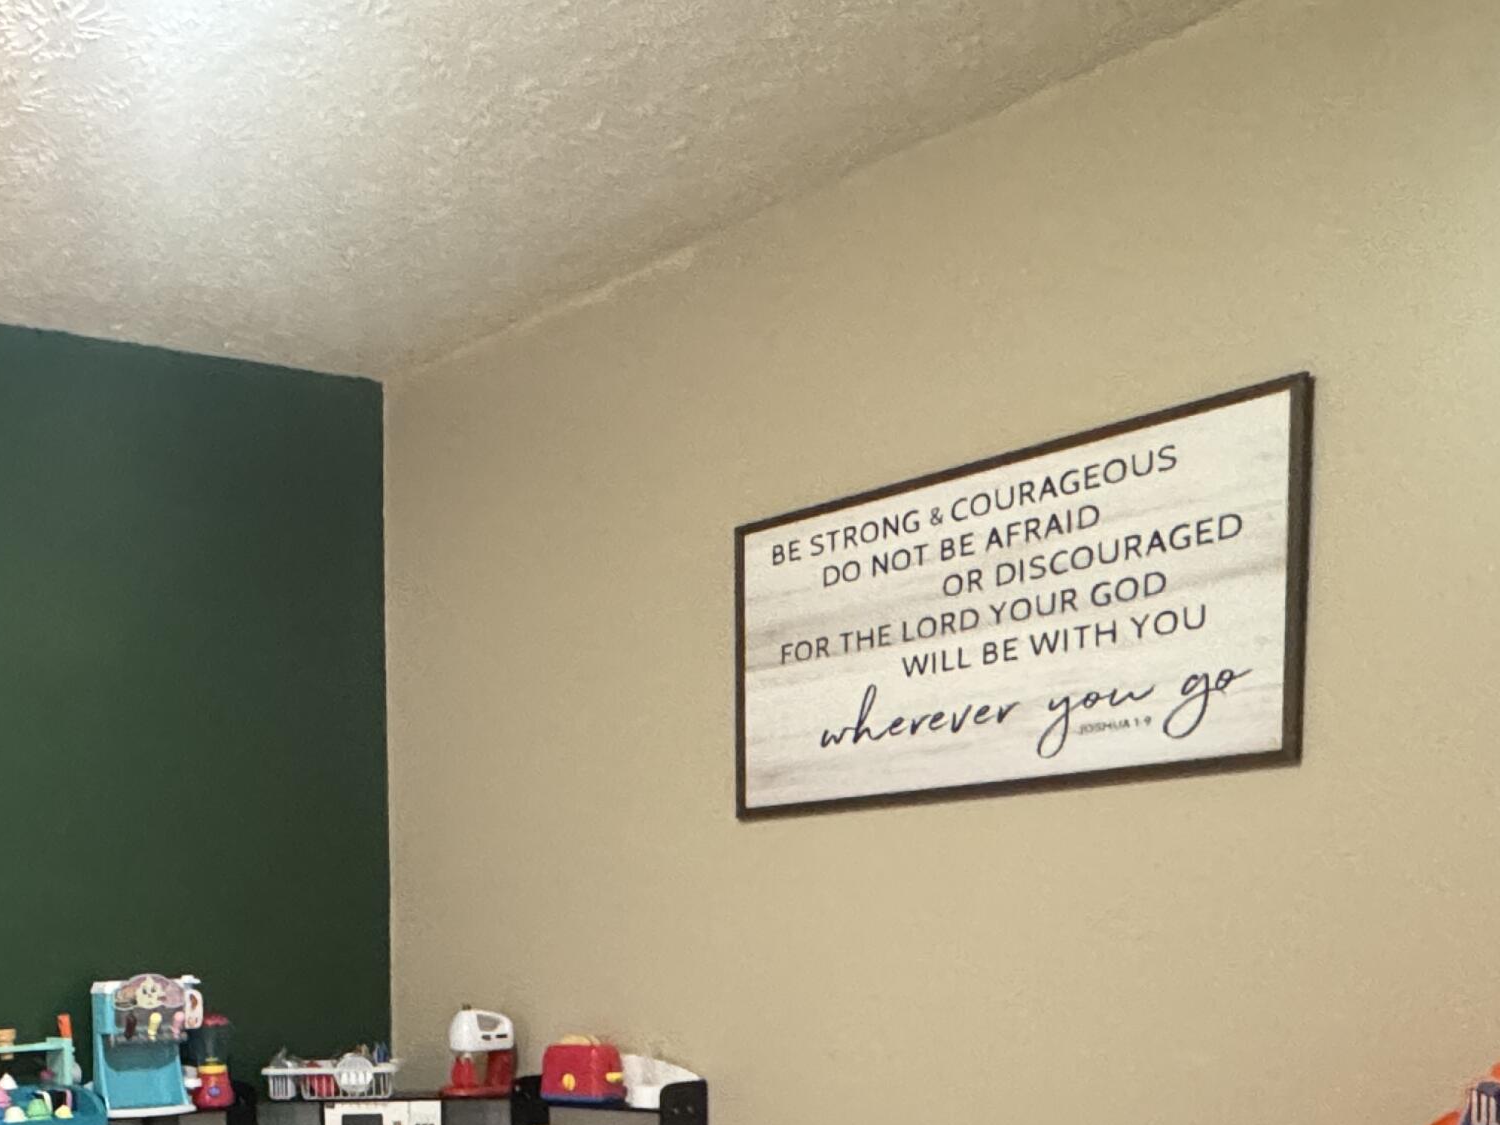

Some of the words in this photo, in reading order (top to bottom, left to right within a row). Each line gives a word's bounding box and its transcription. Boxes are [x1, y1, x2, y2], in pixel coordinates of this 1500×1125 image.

[771, 540, 801, 566] BE
[809, 510, 920, 556] STRONG
[929, 507, 943, 526] &
[951, 444, 1177, 522] COURAGEOUS
[823, 561, 861, 588] DO
[872, 544, 928, 577] NOT
[940, 533, 975, 561] BE
[986, 504, 1100, 550] AFRAID
[943, 568, 983, 597] OR
[996, 513, 1243, 587] DISCOURAGED
[781, 637, 830, 665] FOR
[840, 624, 892, 654] THE
[902, 608, 979, 643] LORD
[989, 588, 1078, 625] YOUR
[1090, 571, 1167, 607] GOD
[902, 647, 971, 677] WILL
[982, 638, 1019, 665] BE
[1029, 620, 1117, 657] WITH
[1130, 604, 1206, 639] YOU
[820, 684, 1019, 748] wherever
[1036, 684, 1156, 759] you
[1162, 667, 1253, 739] go
[1078, 718, 1131, 735] JOSHUA
[1134, 715, 1152, 728] 19
